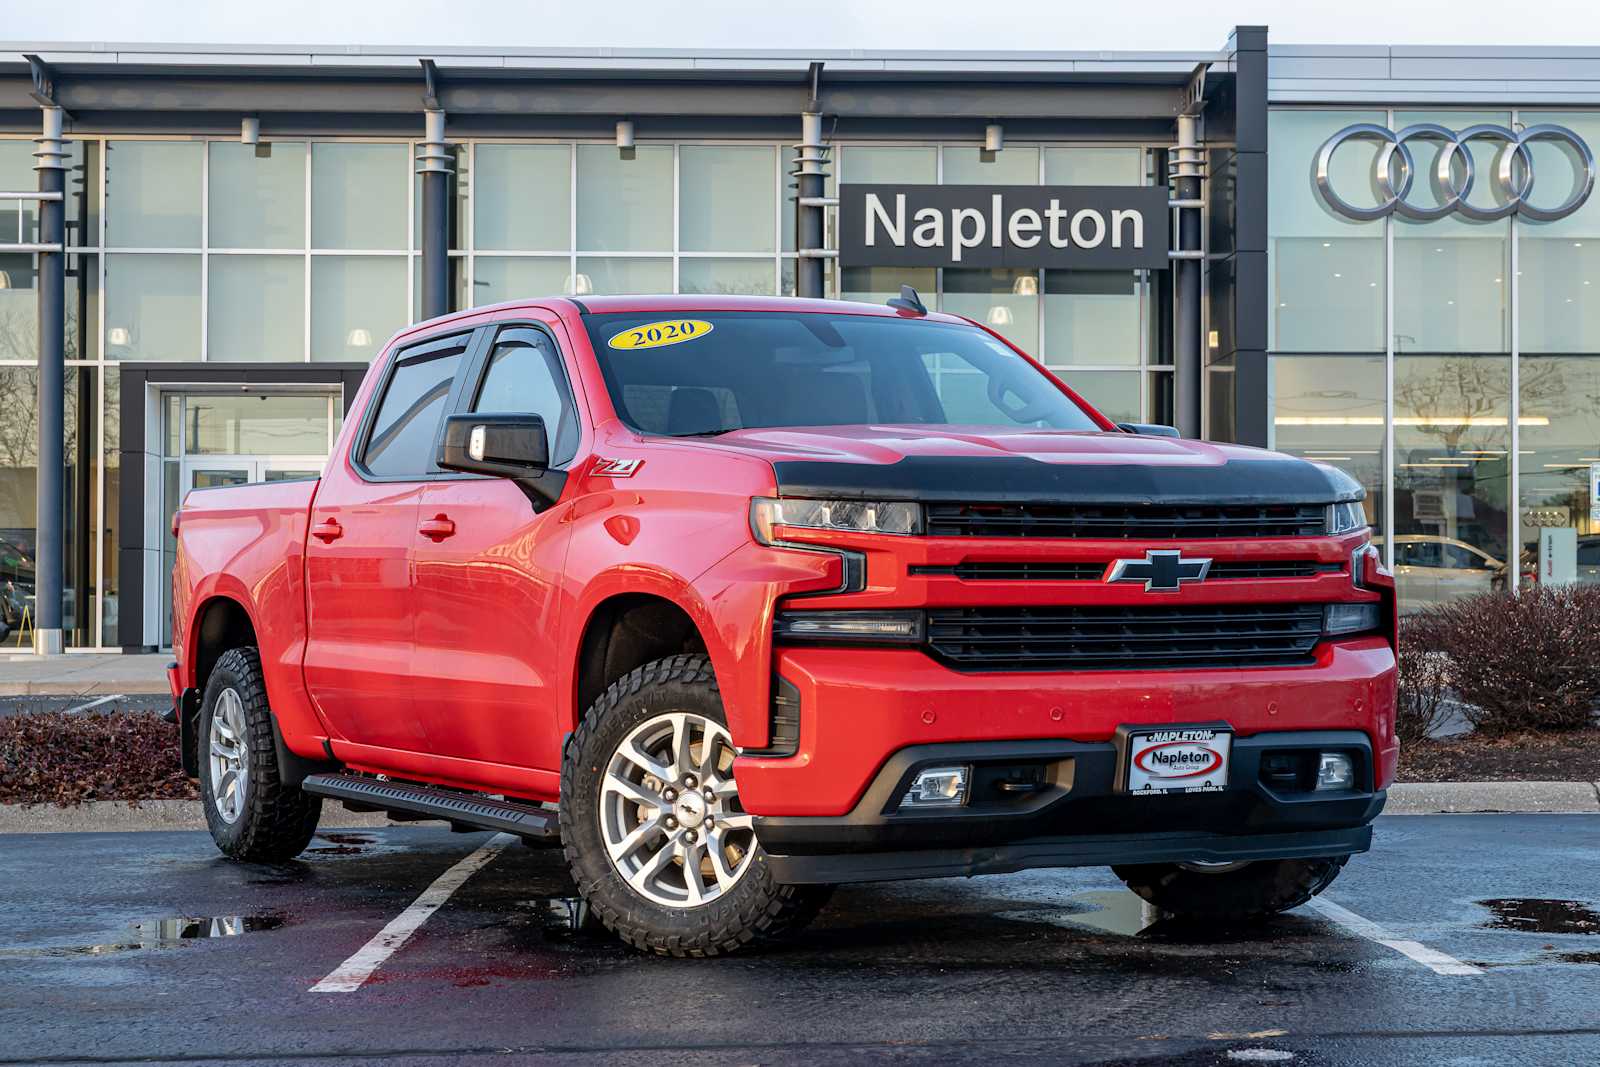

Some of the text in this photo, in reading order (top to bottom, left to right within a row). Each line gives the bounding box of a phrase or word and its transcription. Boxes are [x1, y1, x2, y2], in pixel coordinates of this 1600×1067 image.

[865, 193, 1144, 262] Napleton
[631, 322, 695, 346] 2020
[589, 457, 643, 478] Z71
[1152, 731, 1212, 742] NAPLETON
[1152, 750, 1210, 767] Napleton
